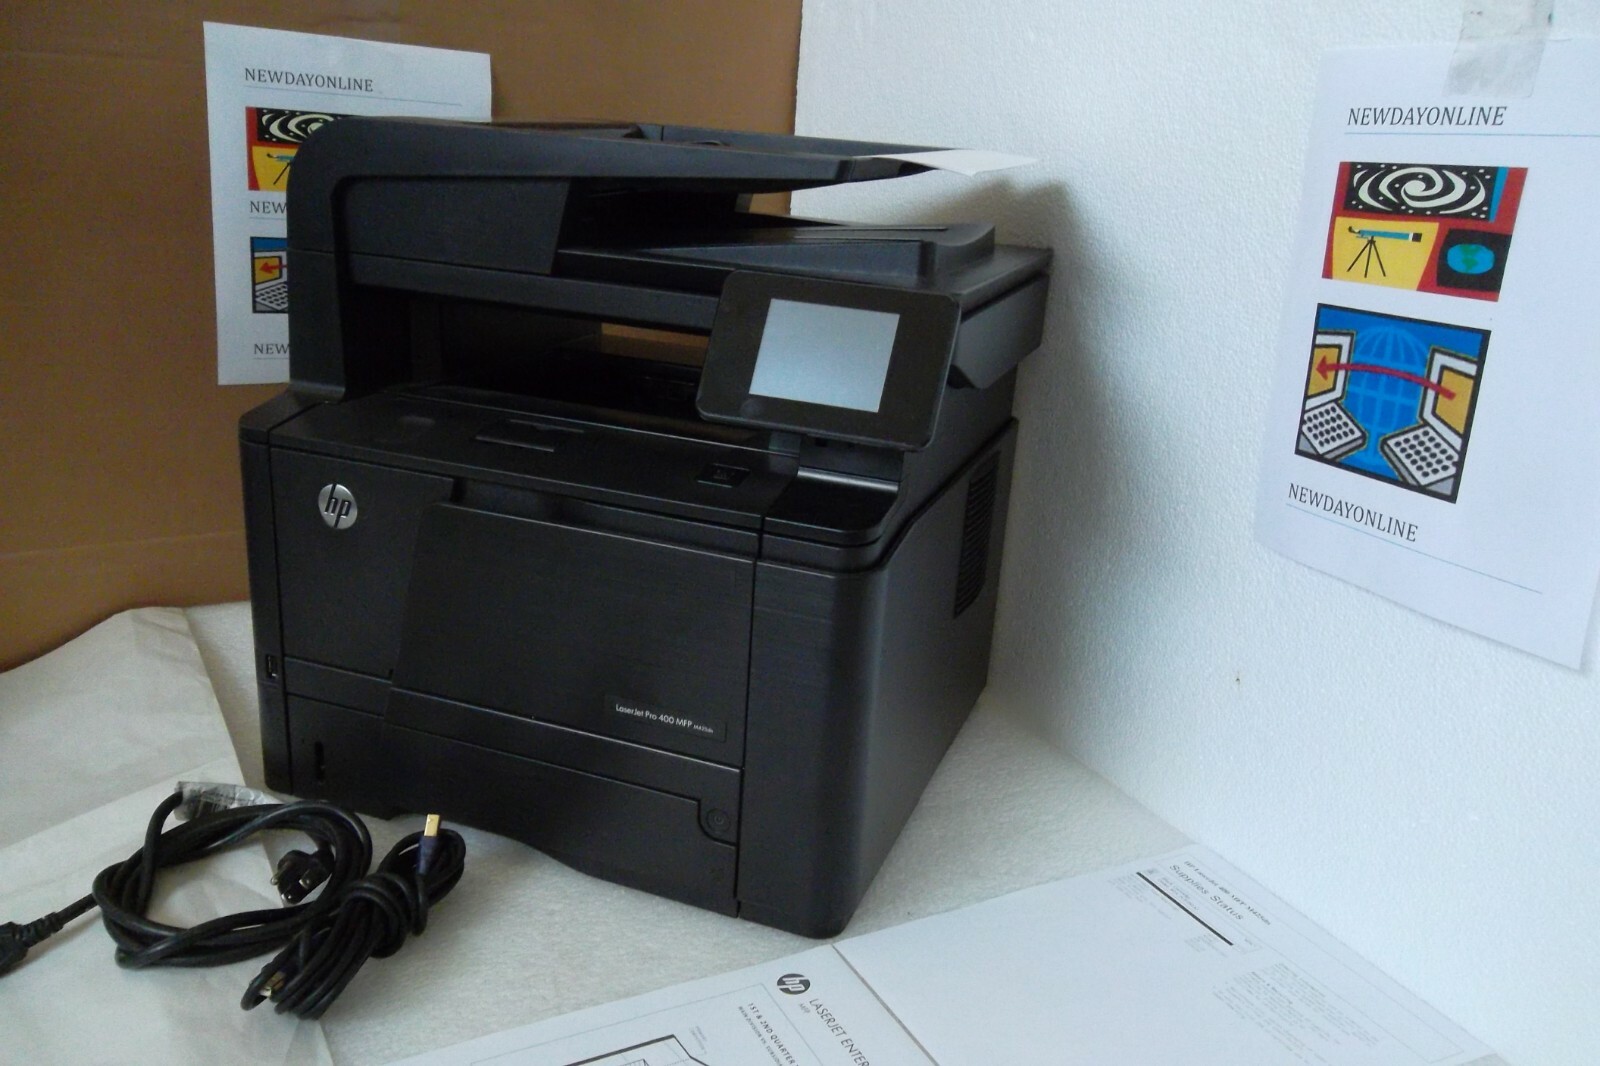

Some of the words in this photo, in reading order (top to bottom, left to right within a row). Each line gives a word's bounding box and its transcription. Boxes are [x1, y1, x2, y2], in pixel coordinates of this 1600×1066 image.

[245, 67, 374, 92] NEWDAYONLINE
[1347, 105, 1508, 127] NEWDAYONLINE
[320, 484, 356, 529] hp
[1288, 482, 1419, 542] NEWDAYONLINE
[615, 703, 644, 717] LaserJet
[645, 710, 657, 721] Pro
[658, 714, 675, 724] 400
[675, 717, 693, 728] MFP
[1169, 864, 1209, 895] Supplies
[1210, 895, 1244, 920] Status
[777, 974, 810, 994] hp
[809, 998, 847, 1037] LASERJET
[770, 1034, 796, 1065] QUARTER
